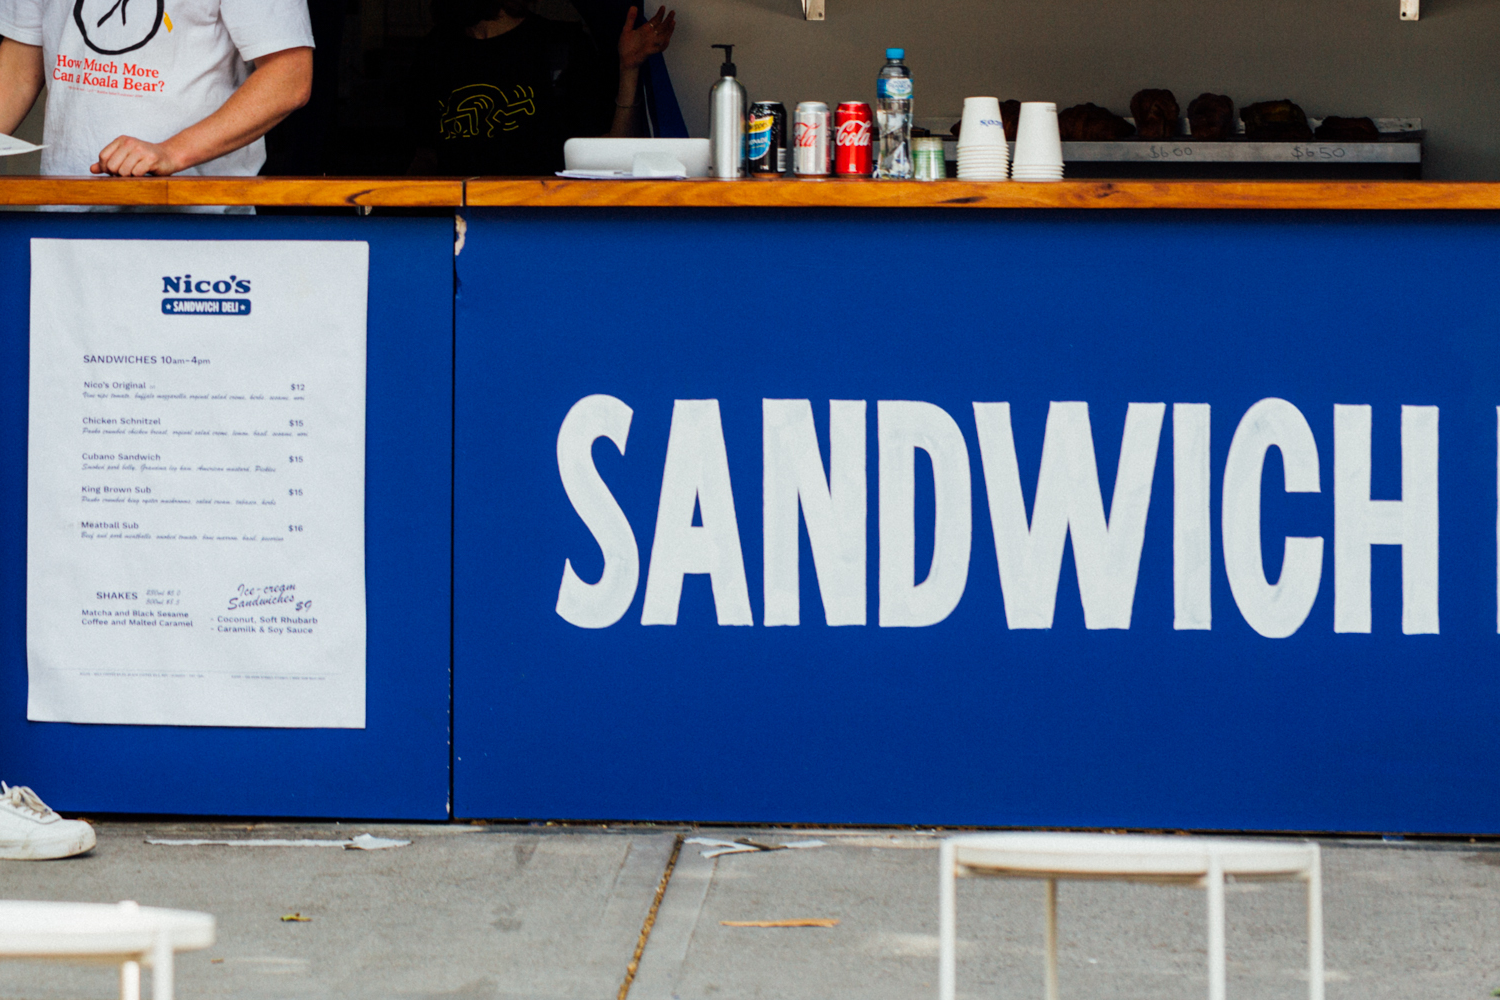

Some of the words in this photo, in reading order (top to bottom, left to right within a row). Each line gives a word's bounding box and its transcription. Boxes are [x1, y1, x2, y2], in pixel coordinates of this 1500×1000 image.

[56, 54, 83, 70] How
[83, 57, 118, 74] Much
[122, 63, 160, 78] More
[52, 68, 74, 83] Can
[76, 75, 81, 84] a
[82, 72, 118, 89] Koala
[123, 77, 165, 93] Bear?
[836, 119, 871, 147] Cola
[162, 274, 251, 294] Nico's
[173, 300, 219, 313] SANDWICH
[221, 301, 239, 313] DELI
[83, 355, 157, 365] SANDWICHES
[84, 381, 109, 389] Nico's
[112, 381, 146, 391] Original
[290, 383, 305, 392] $12
[82, 417, 117, 425] Chicken
[120, 417, 161, 425] Schnitzel
[289, 419, 304, 428] $15
[81, 453, 115, 461] Cubano
[118, 453, 161, 461] Sandwich
[288, 455, 303, 463] $15
[81, 486, 101, 495] King
[103, 486, 132, 494] Brown
[134, 486, 152, 494] Sub
[288, 488, 303, 497] $15
[556, 393, 1440, 639] SANDWICH
[81, 521, 120, 529] Meatball
[122, 521, 139, 530] Sub
[288, 524, 303, 533] $16
[237, 583, 296, 597] Ice-cream
[96, 591, 138, 600] SHAKES
[227, 593, 295, 611] Sandwiches
[295, 600, 312, 612] $9
[81, 609, 112, 617] Matcha
[132, 610, 154, 618] Black
[81, 618, 107, 626] Coffee
[110, 618, 126, 626] and
[128, 619, 157, 627] Malted
[159, 619, 193, 628] Caramel
[259, 616, 278, 624] Soft
[280, 616, 318, 625] Rhubarb
[217, 625, 256, 633] Caramilk
[267, 625, 284, 635] Soy
[286, 626, 313, 634] Sauce
